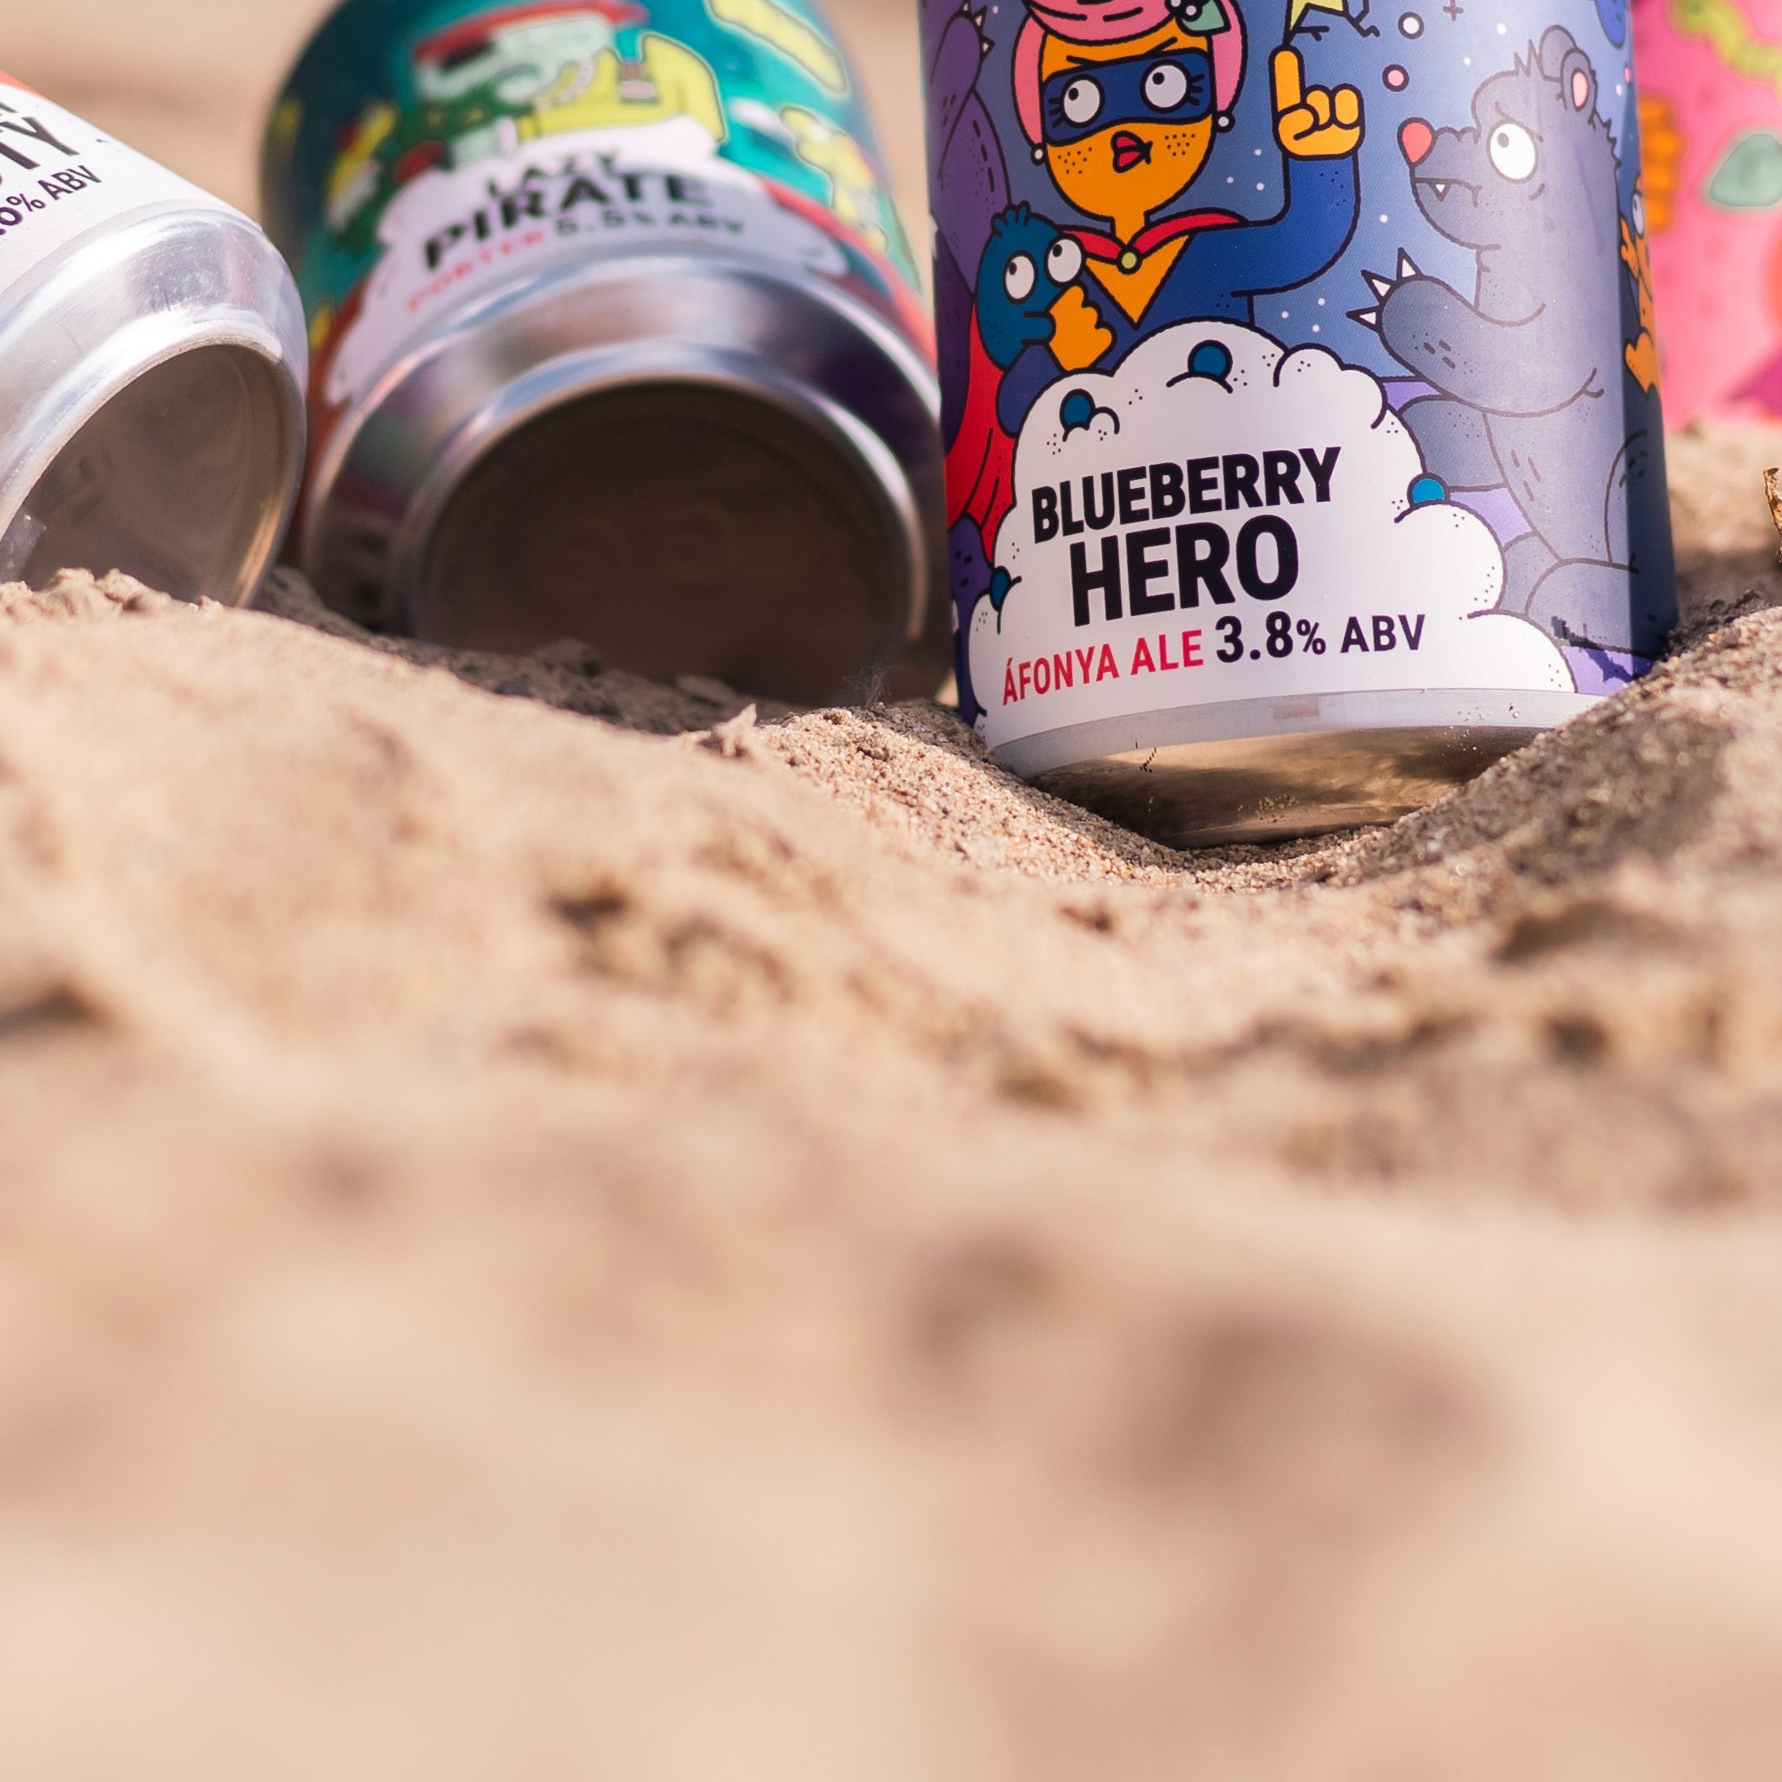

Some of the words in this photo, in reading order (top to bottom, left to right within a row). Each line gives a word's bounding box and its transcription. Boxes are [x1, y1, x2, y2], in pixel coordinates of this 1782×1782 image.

[38, 165, 102, 200] ABV
[425, 173, 712, 271] PIRATE
[1031, 447, 1341, 544] BLUEBERRY
[1069, 514, 1299, 627] HERO
[1002, 643, 1119, 705] ÁFONYA
[1130, 629, 1204, 676] ALE
[1216, 611, 1327, 663] 3.8%
[1340, 614, 1426, 654] ABV
